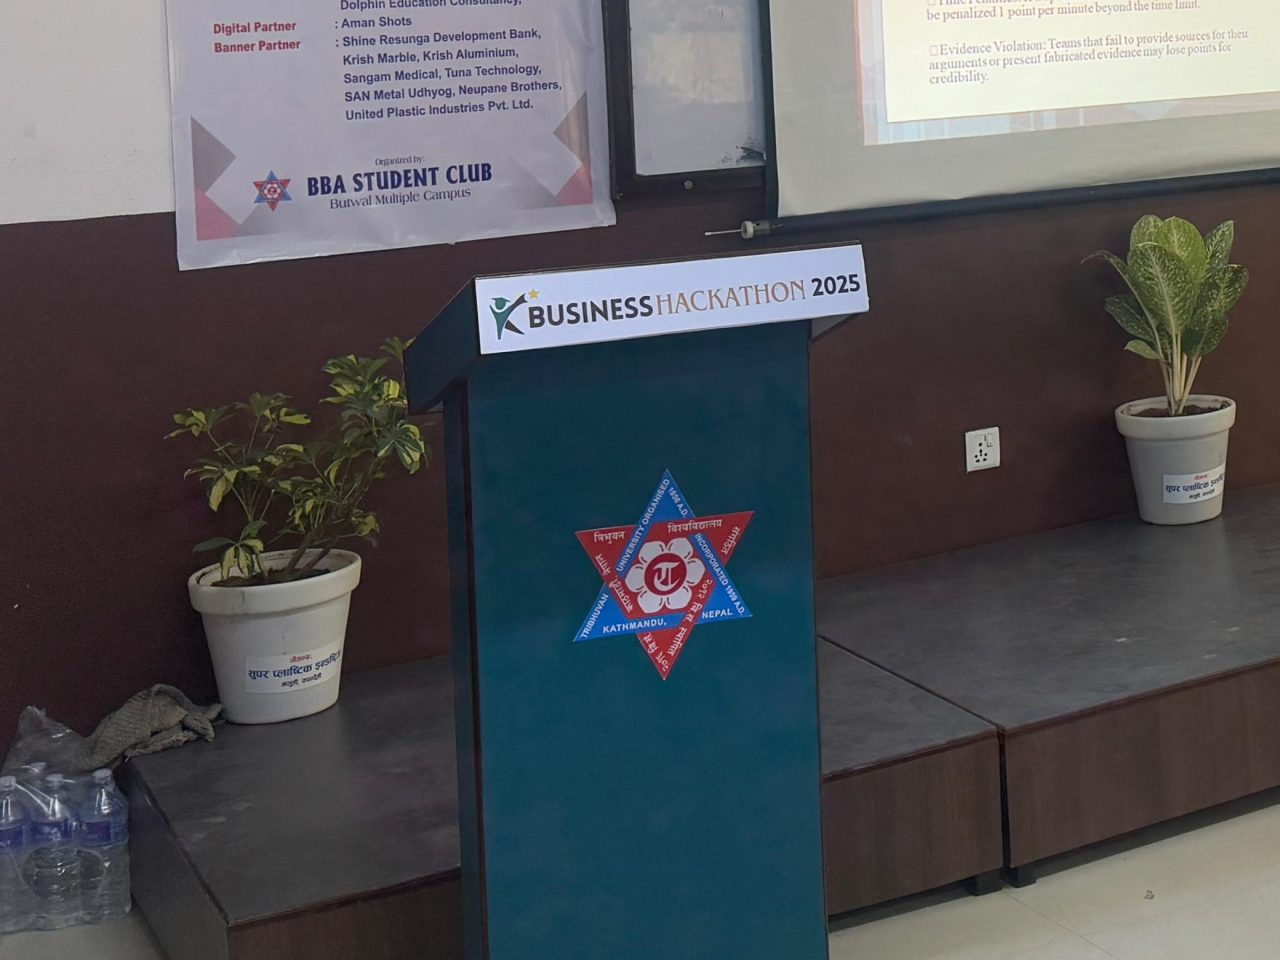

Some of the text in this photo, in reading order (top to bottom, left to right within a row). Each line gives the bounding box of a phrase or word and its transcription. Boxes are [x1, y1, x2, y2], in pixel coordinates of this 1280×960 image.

[927, 9, 940, 21] be
[943, 7, 996, 22] penalized
[1008, 5, 1036, 19] point
[1037, 6, 1055, 17] per
[1057, 2, 1094, 15] minute
[1095, 1, 1132, 16] beyond
[1133, 0, 1149, 12] the
[1151, 0, 1173, 11] time
[213, 15, 412, 36] Digital Partner Aman Shots
[929, 70, 989, 86] credibility.
[307, 163, 492, 196] BBA STUDENT CLUB
[330, 188, 471, 210] Butwal Multiple Campus
[811, 274, 861, 297] 2025
[616, 524, 645, 572] UNIVERSITY
[641, 479, 670, 525] ORGANISED
[694, 532, 729, 586] INCORPORATED
[580, 593, 609, 638] TRIBHUVAN
[702, 610, 733, 619] NEPAL
